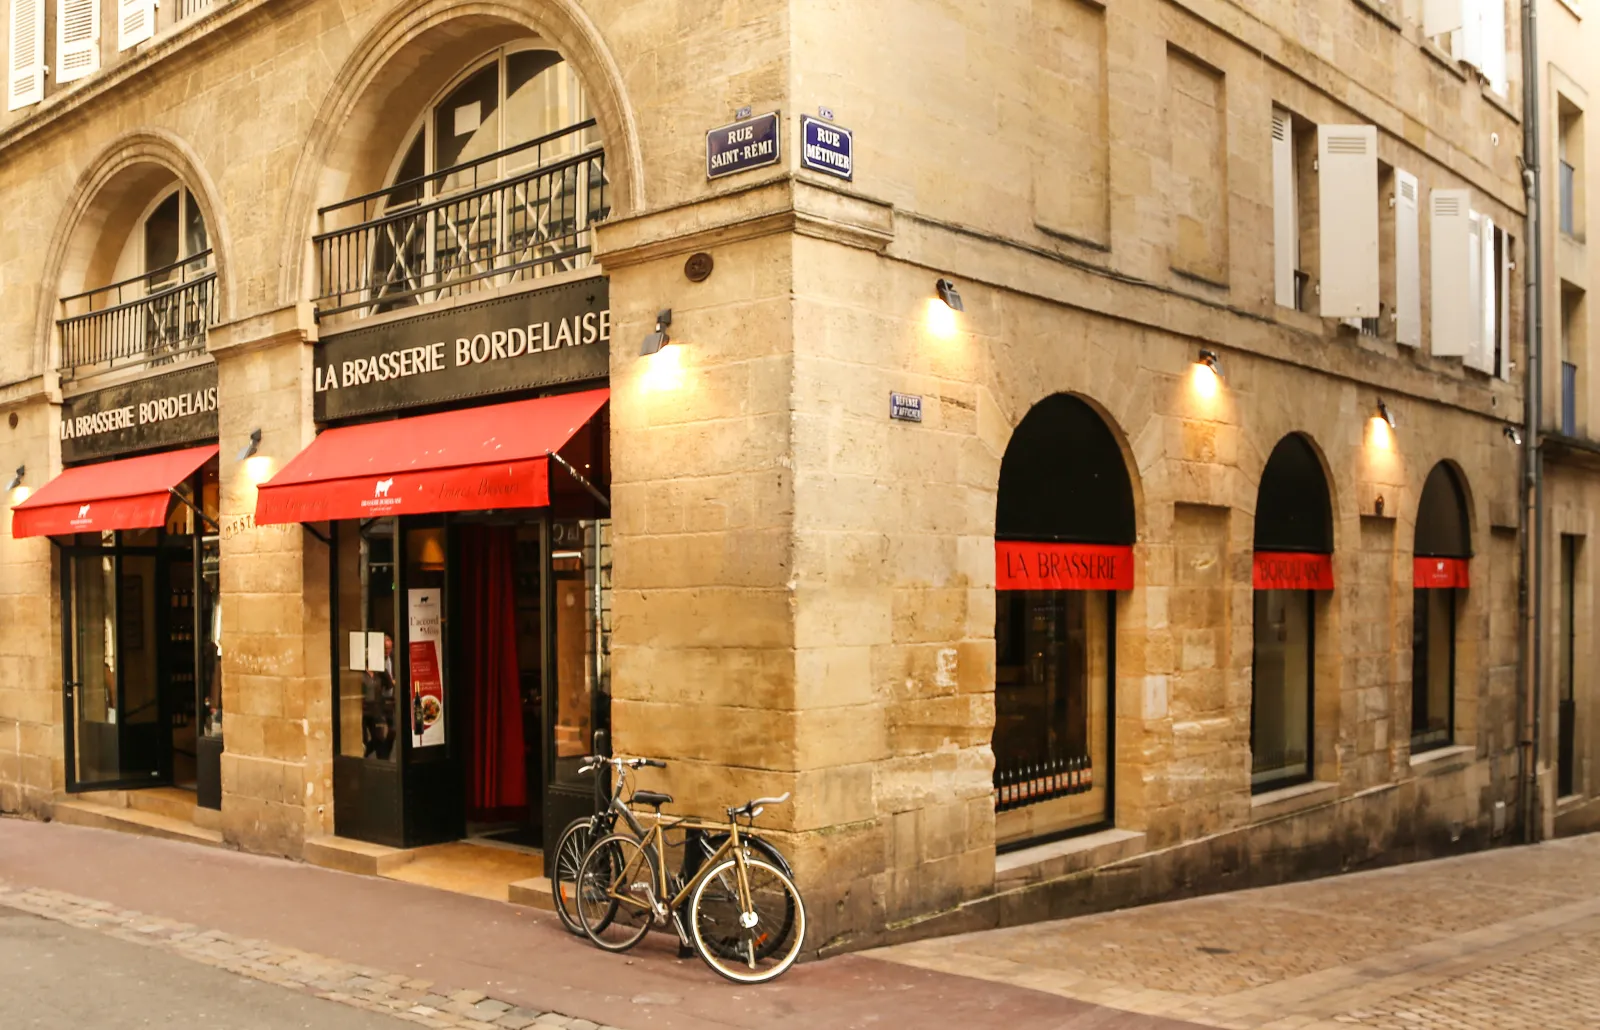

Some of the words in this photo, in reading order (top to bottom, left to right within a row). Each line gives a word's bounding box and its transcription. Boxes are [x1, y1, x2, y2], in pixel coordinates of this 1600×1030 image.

[727, 126, 753, 145] RUE
[817, 127, 840, 148] RUE
[711, 140, 773, 169] SAINT-RÉMI
[806, 144, 850, 169] MÉTIVIER
[315, 363, 338, 392] LA
[342, 342, 445, 388] BRASSERIE
[455, 309, 610, 367] BORDELAISE
[61, 420, 75, 440] LA
[76, 405, 135, 437] BRASSERIE
[139, 387, 219, 425] BORDELAIS
[1006, 552, 1029, 579] LA
[1038, 552, 1117, 580] BRASSERIE
